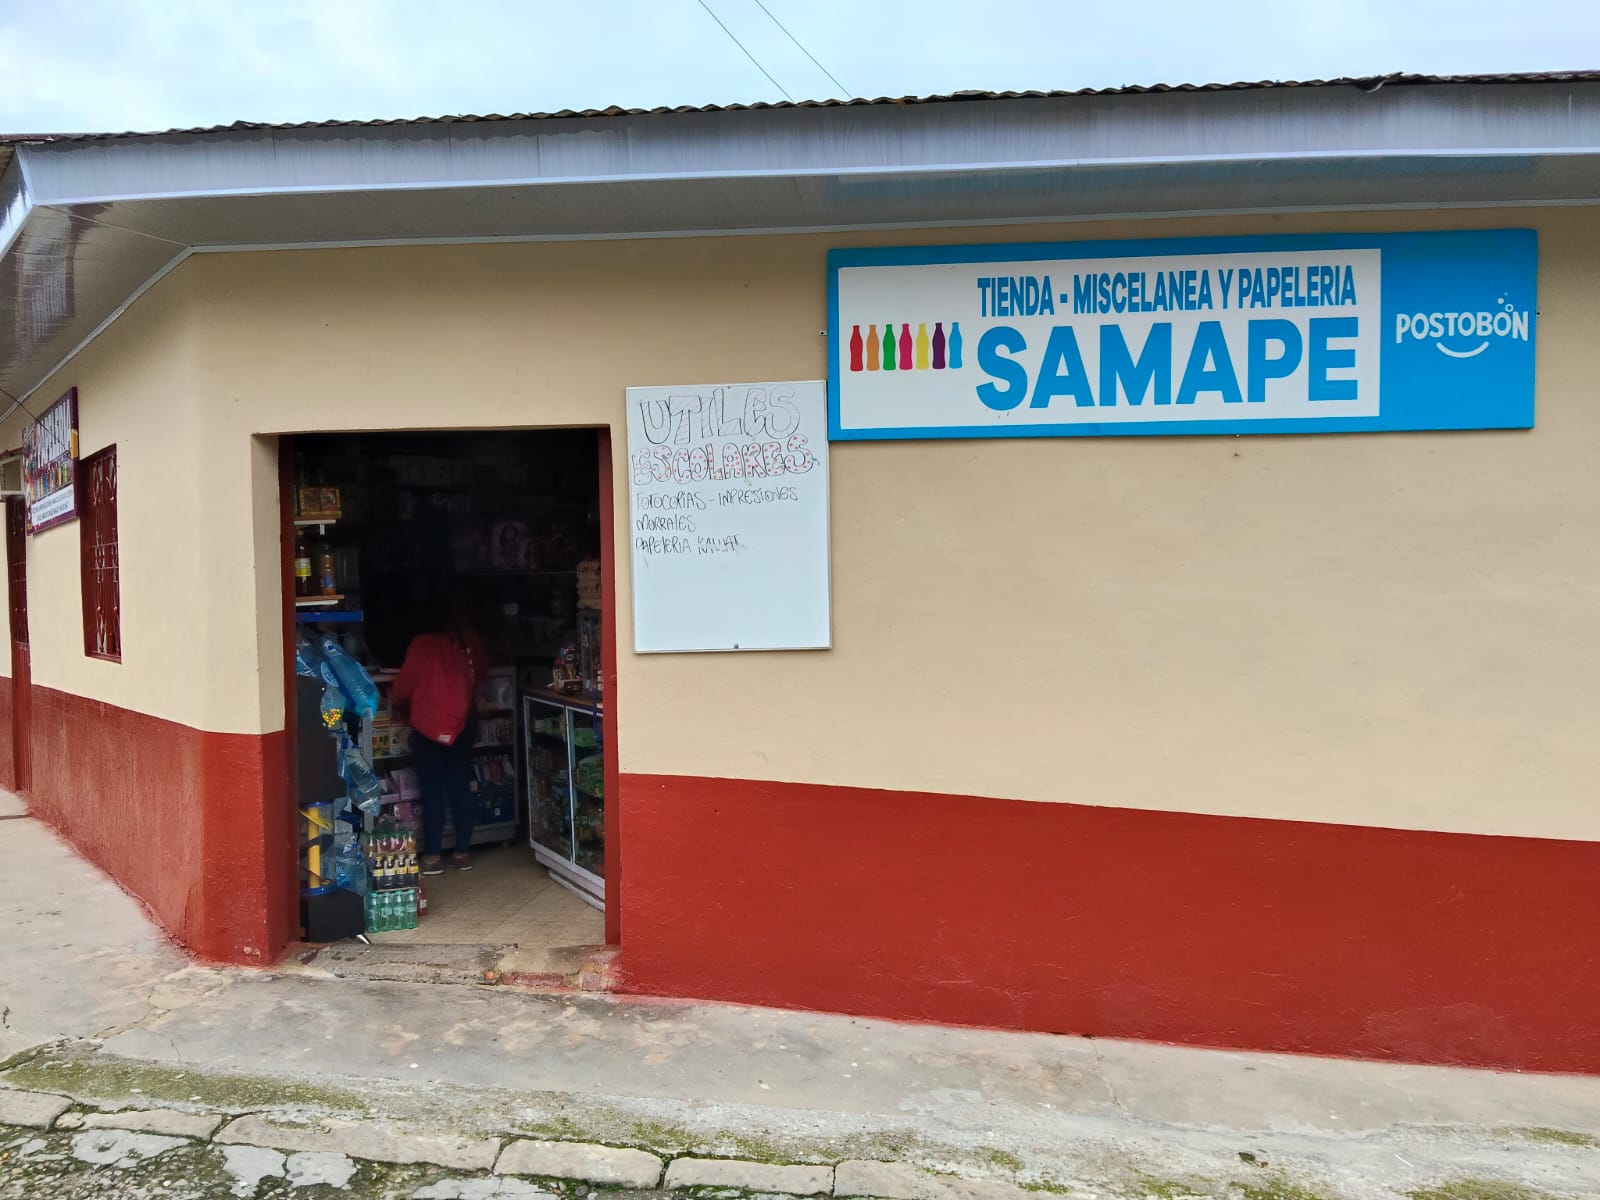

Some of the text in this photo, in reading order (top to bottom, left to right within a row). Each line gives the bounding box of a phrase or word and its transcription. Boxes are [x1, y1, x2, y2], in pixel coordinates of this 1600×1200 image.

[977, 275, 1055, 318] TIENDA
[1073, 269, 1214, 314] MISCELANEA
[1218, 268, 1234, 310] Y
[1238, 264, 1357, 309] PAPELERIA
[976, 316, 1359, 412] SAMAPE
[639, 387, 800, 445] UTILES
[632, 434, 814, 486] ESCOLARES
[636, 513, 696, 533] MORRALES
[637, 490, 707, 510] FOTOCOPIAS
[718, 486, 799, 506] IMPRESIONES
